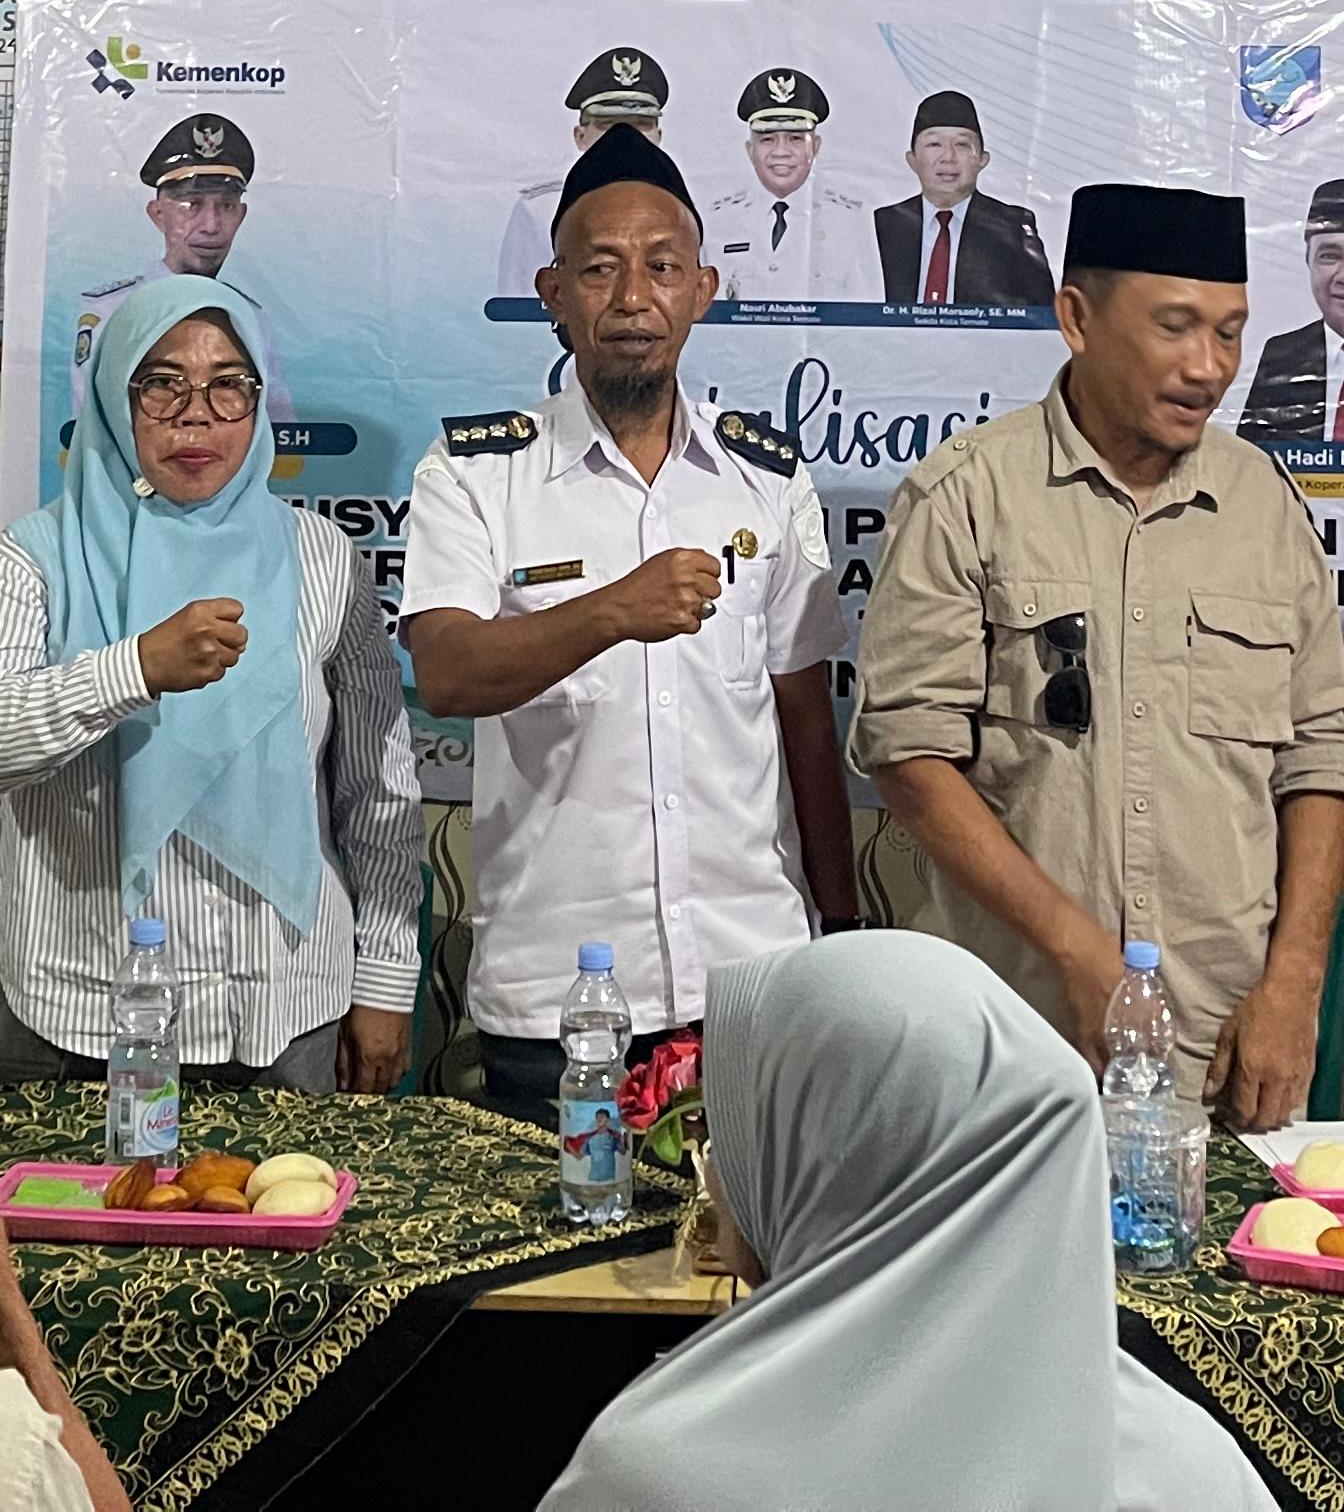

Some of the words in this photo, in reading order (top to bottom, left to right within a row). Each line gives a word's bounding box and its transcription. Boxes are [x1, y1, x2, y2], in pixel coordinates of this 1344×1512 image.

[156, 61, 285, 87] Kemenkop
[278, 429, 310, 447] S.H
[1287, 449, 1333, 466] Hadi
